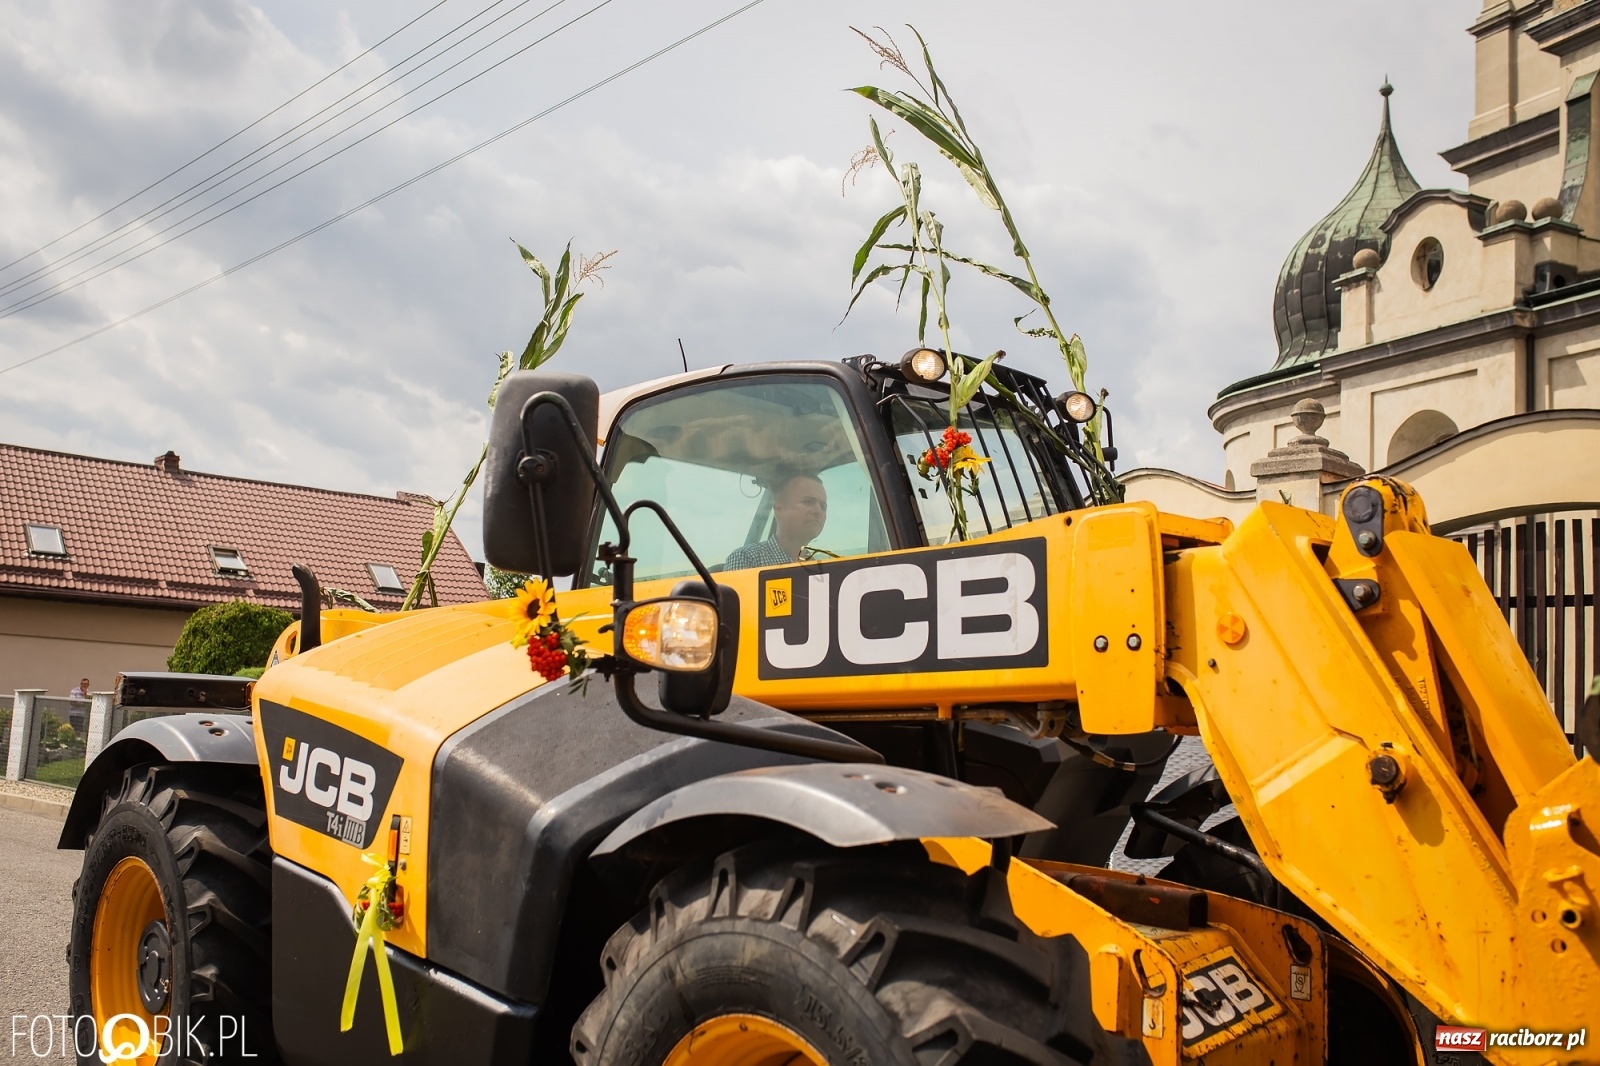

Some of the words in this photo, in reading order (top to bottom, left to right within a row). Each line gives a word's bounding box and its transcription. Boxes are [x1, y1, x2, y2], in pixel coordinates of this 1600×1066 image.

[765, 552, 1039, 669] JCB
[772, 589, 788, 607] JCB
[279, 742, 376, 821] JCB
